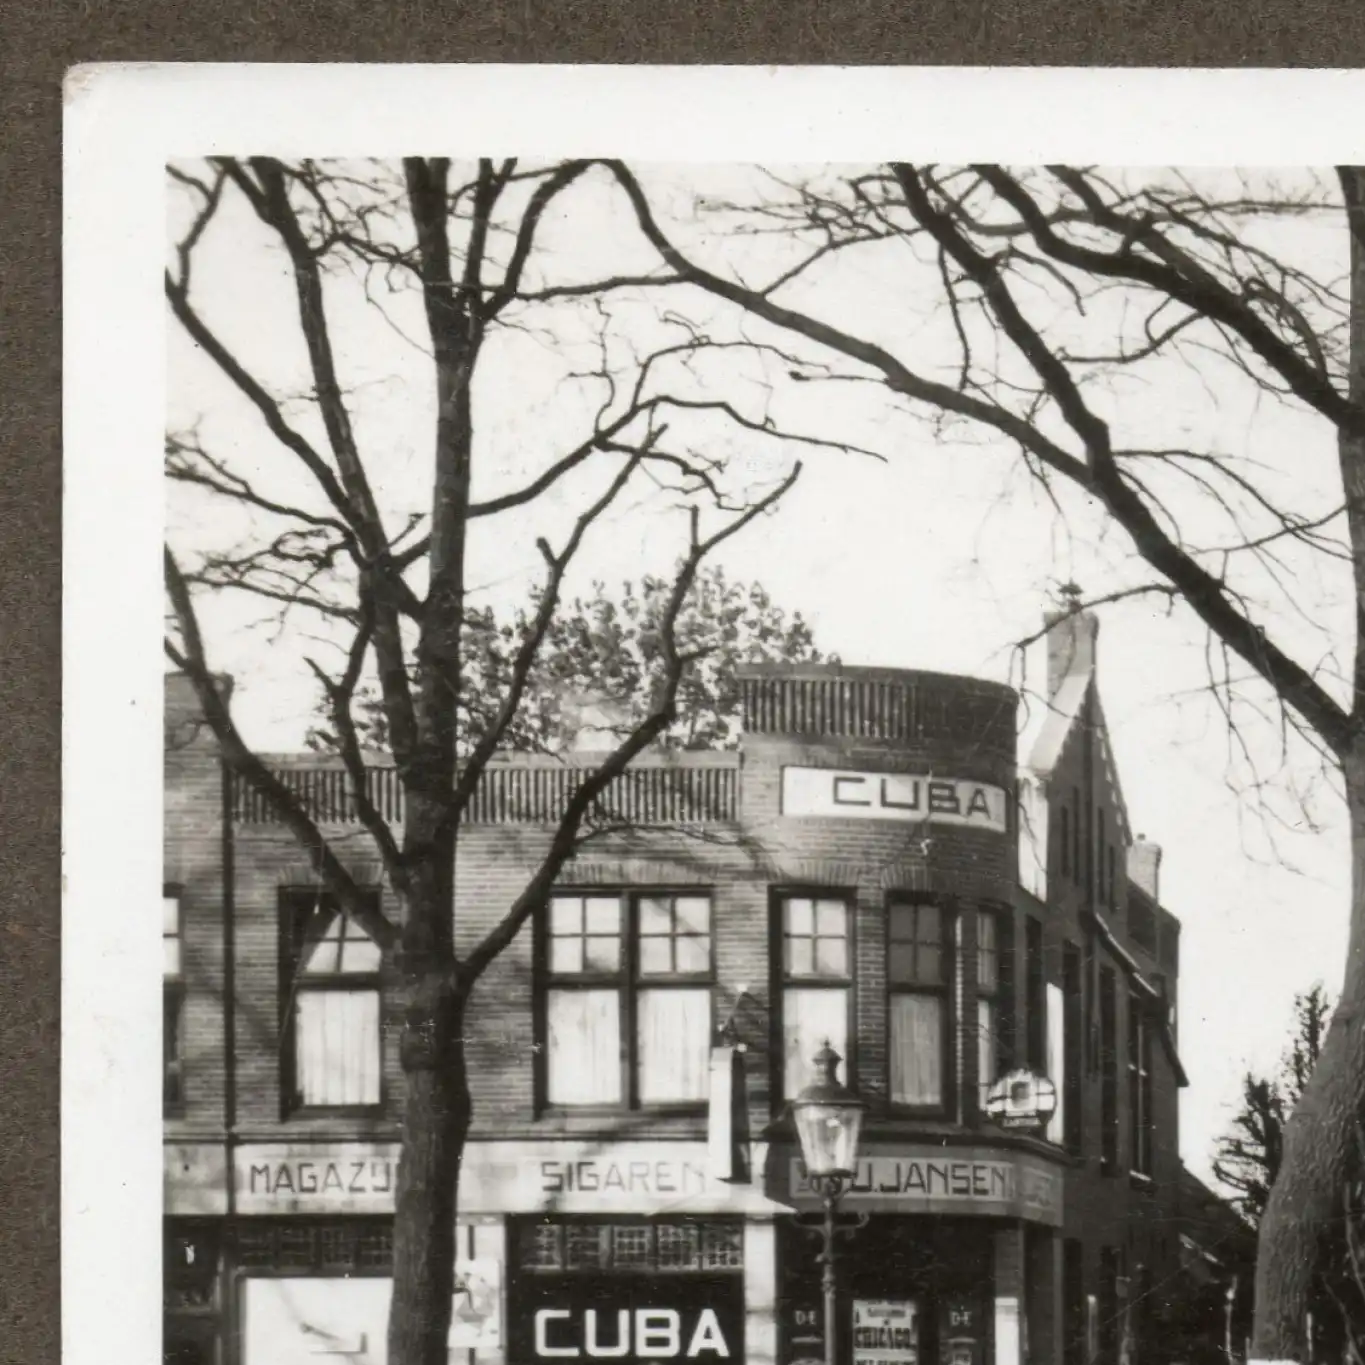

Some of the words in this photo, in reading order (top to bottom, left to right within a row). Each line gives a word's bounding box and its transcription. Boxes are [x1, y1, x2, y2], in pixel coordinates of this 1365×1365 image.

[833, 776, 991, 819] CUBA
[249, 1161, 391, 1194] MAGAZIJ
[540, 1161, 707, 1194] SIGAREN
[534, 1308, 730, 1358] CUBA
